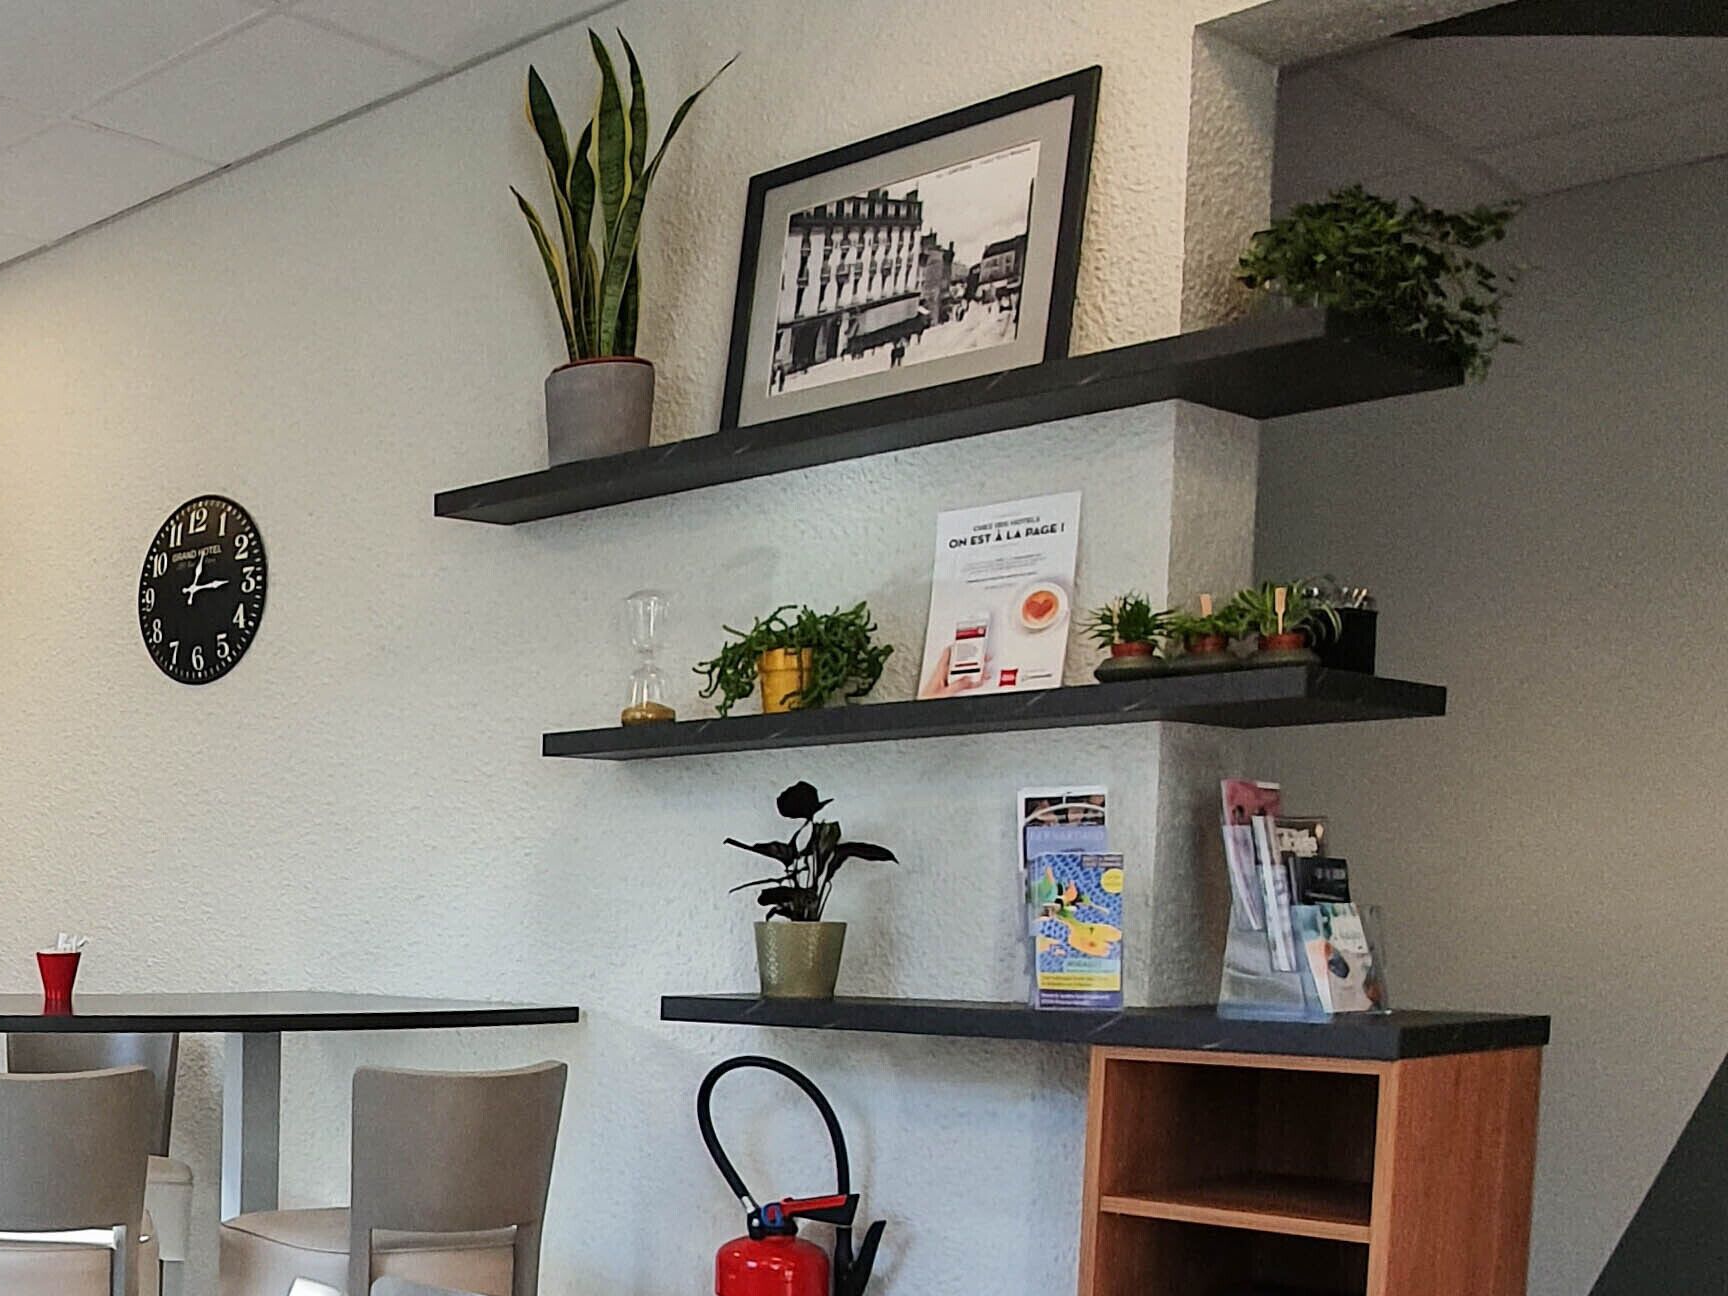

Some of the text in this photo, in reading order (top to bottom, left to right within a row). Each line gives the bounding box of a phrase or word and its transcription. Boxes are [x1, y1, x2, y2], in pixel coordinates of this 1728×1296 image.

[188, 507, 208, 534] 12
[218, 511, 227, 537] 1
[169, 522, 183, 548] 11
[234, 534, 249, 560] 2
[948, 538, 967, 549] ON
[970, 533, 991, 546] EST
[995, 529, 1003, 542] À
[1006, 530, 1022, 541] LA
[1025, 523, 1057, 537] PAGE
[153, 551, 168, 578] 10
[172, 544, 222, 562] GRAND HOTEL
[241, 566, 256, 593] 3
[145, 588, 155, 612] 9
[232, 603, 245, 629] 4
[152, 618, 162, 644] 8
[169, 640, 180, 665] 7
[192, 645, 204, 671] 6
[216, 633, 229, 658] 5
